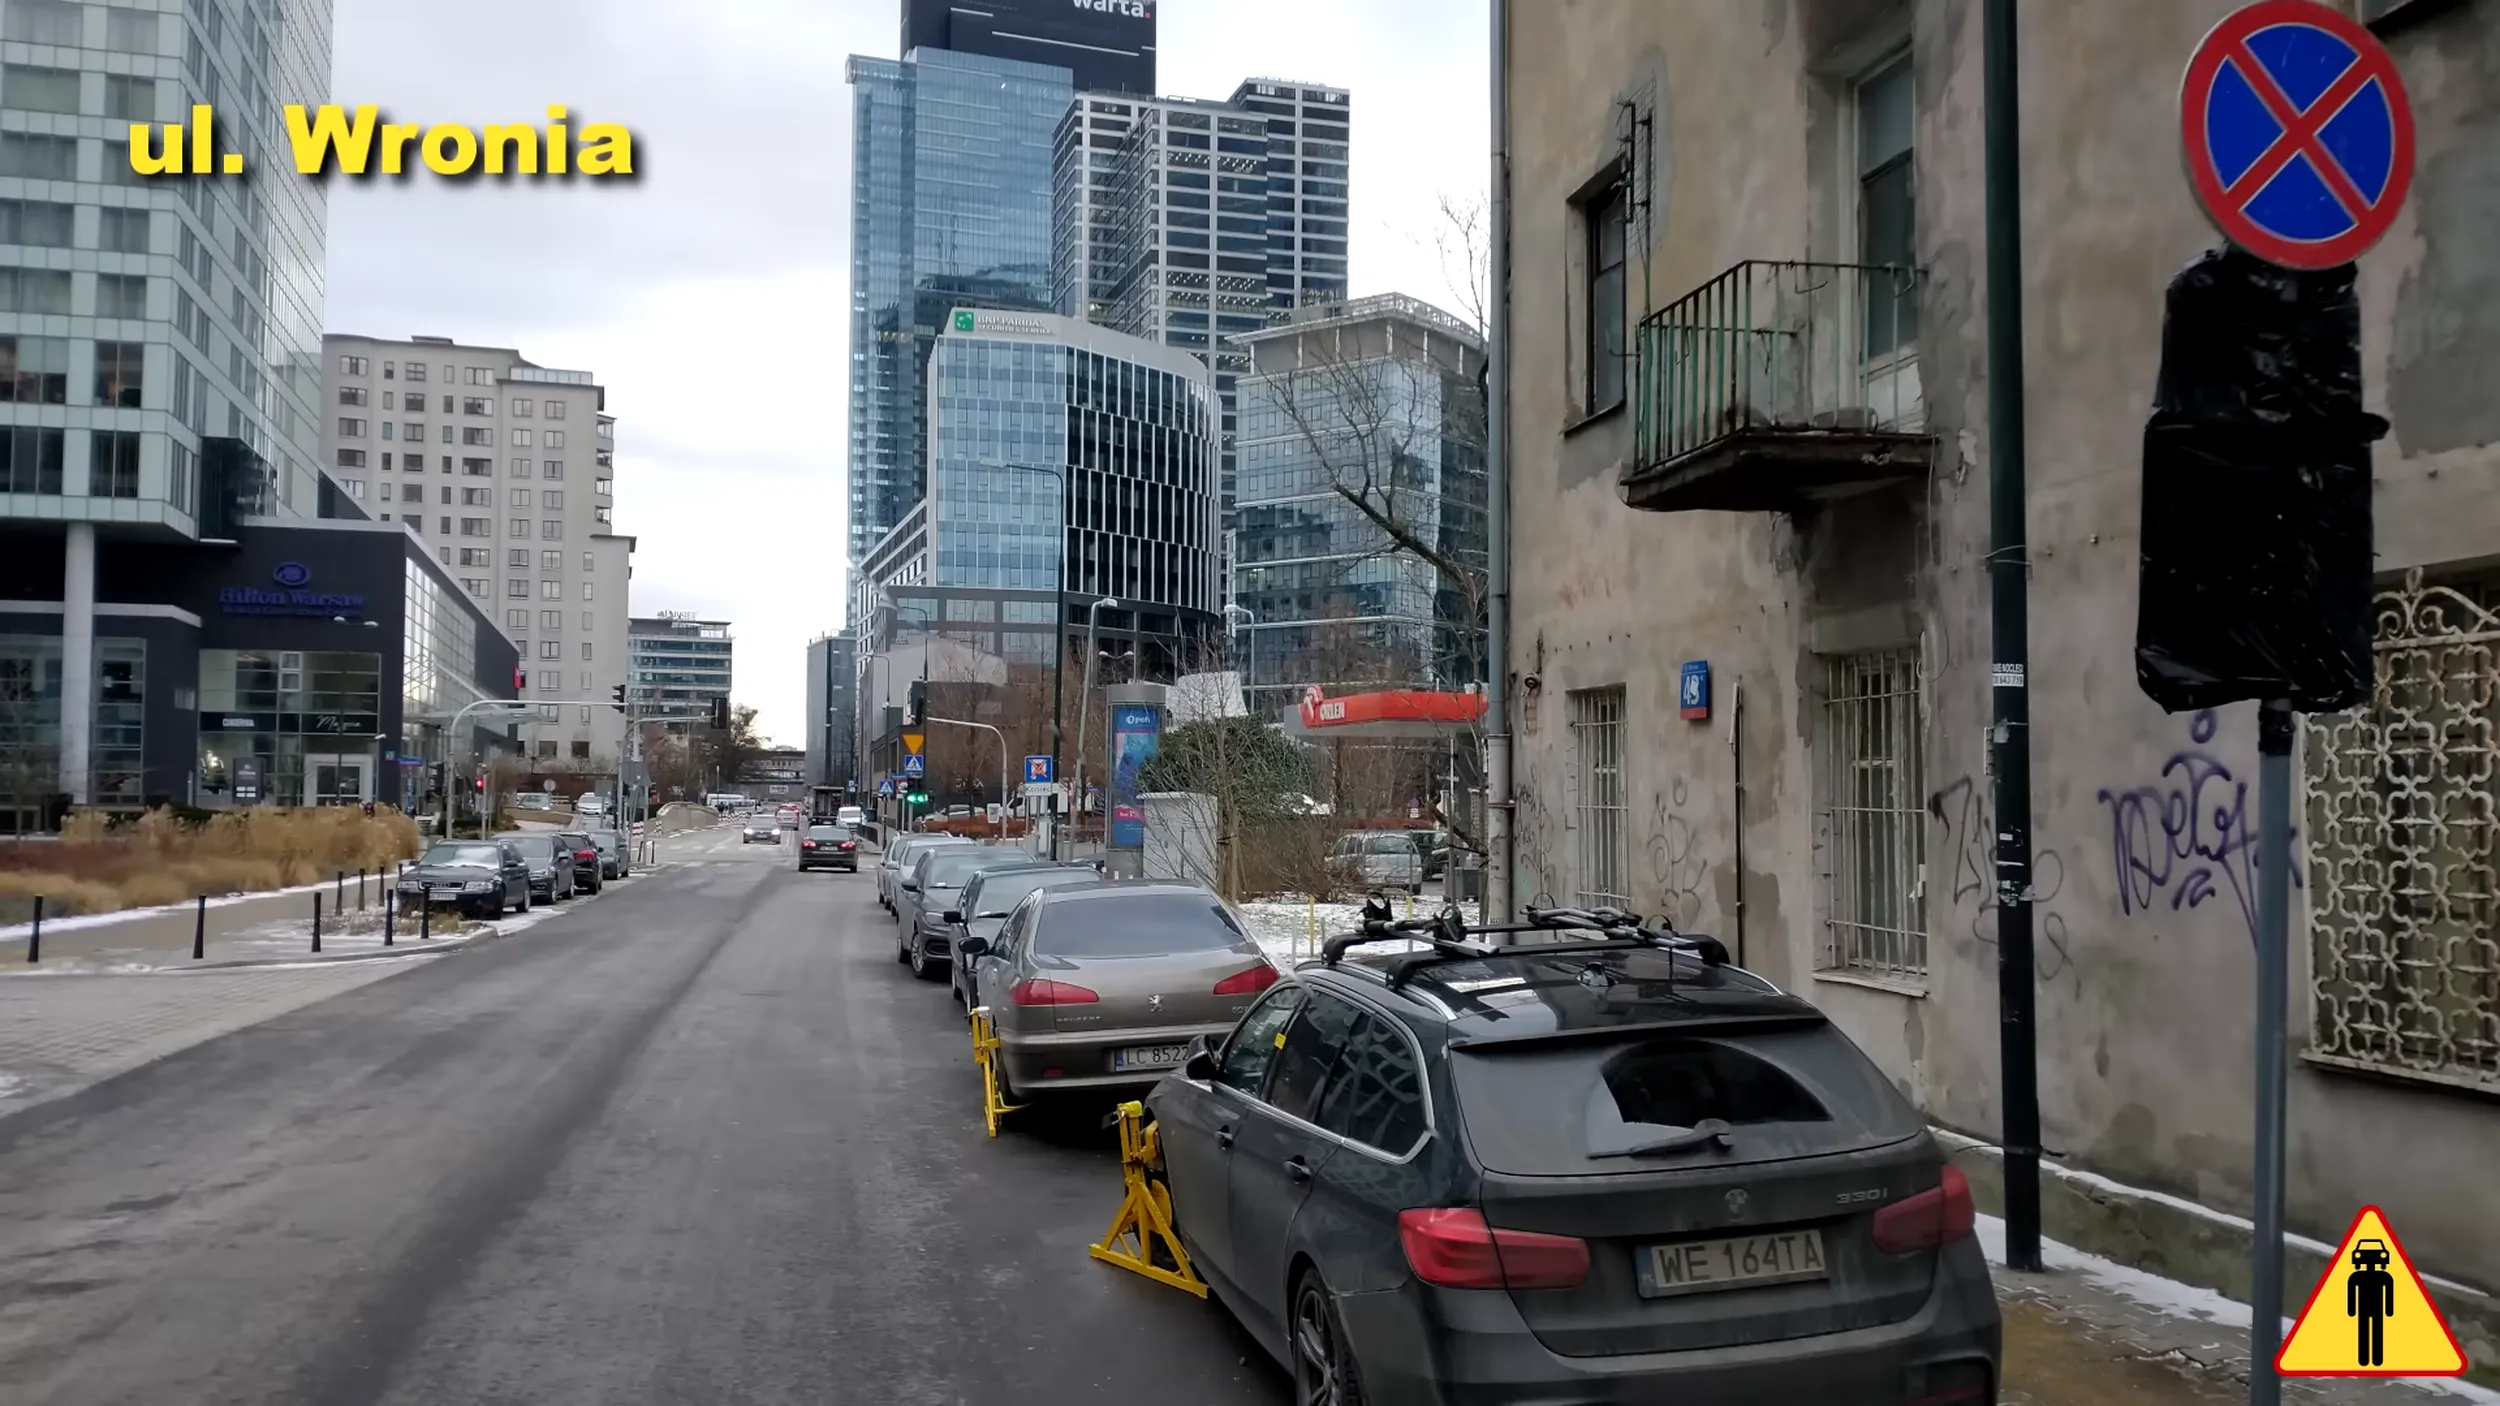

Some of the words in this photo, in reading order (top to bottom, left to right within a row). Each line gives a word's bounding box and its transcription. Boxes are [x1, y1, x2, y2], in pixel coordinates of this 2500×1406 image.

[220, 586, 286, 605] Hilton
[1126, 1048, 1146, 1066] LC
[1152, 1046, 1189, 1063] 8522
[1658, 1245, 1710, 1283] WE
[1723, 1233, 1822, 1278] 164TA
